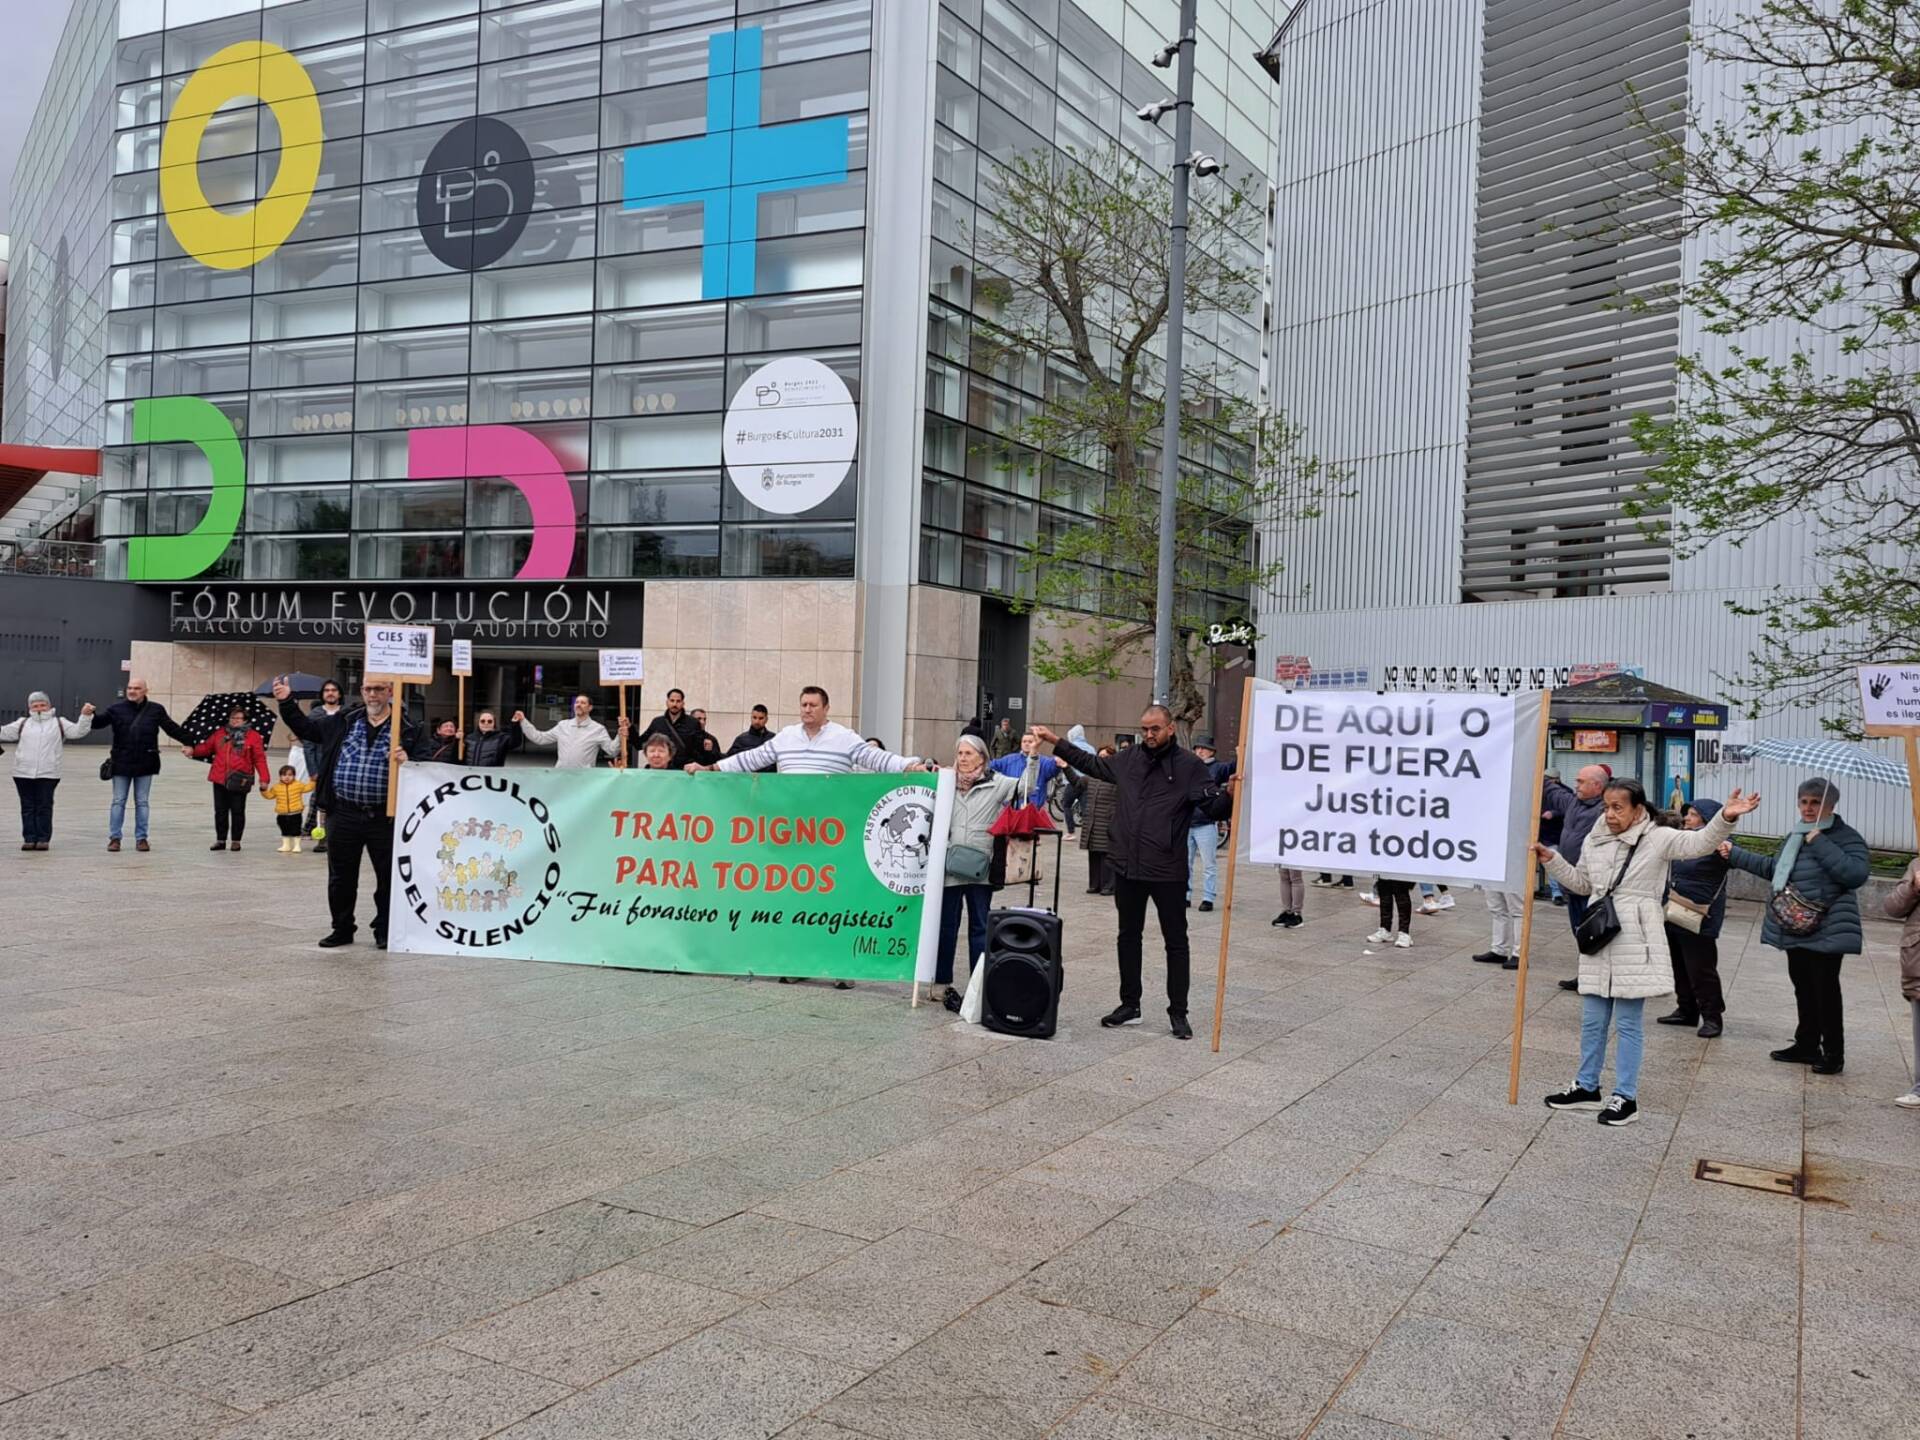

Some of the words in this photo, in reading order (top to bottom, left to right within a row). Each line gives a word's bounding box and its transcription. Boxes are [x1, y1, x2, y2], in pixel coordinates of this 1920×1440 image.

[736, 426, 844, 445] #BurgosEsCultura2031
[171, 585, 301, 621] FÓRUM
[331, 584, 611, 623] EVOLUCIÓN
[170, 618, 253, 634] PALACIO
[263, 620, 285, 635] DE
[377, 631, 403, 642] CIES
[473, 621, 608, 638] AUDITORIO
[1385, 666, 1398, 682] NO
[1404, 666, 1417, 683] NO
[1423, 667, 1437, 683] NO
[1443, 667, 1457, 683] NO
[1484, 667, 1499, 684] NO
[1507, 667, 1522, 684] NO
[1529, 668, 1545, 685] NO
[1552, 667, 1569, 685] NO
[1274, 703, 1324, 734] DE
[1336, 699, 1435, 737] AQUÍ
[1459, 707, 1490, 738] O
[1886, 710, 1899, 718] es
[1280, 743, 1331, 773] DE
[1345, 745, 1482, 779] FUERA
[1696, 739, 1719, 764] DIC
[401, 774, 562, 854] CIRCULOS
[864, 795, 893, 841] PASTORAL
[896, 786, 916, 797] CON
[1304, 783, 1450, 820] Justicia
[610, 810, 715, 844] TRATO
[729, 815, 846, 847] DIGNO
[1278, 827, 1357, 857] para
[1368, 828, 1478, 863] todos
[615, 856, 699, 890] PARA
[711, 861, 837, 894] TODOS
[397, 855, 430, 925] DEL
[435, 861, 561, 947] SILENCIO
[626, 895, 719, 926] forastero
[728, 909, 742, 932] y
[750, 909, 783, 925] me
[852, 935, 881, 960] (Mt.
